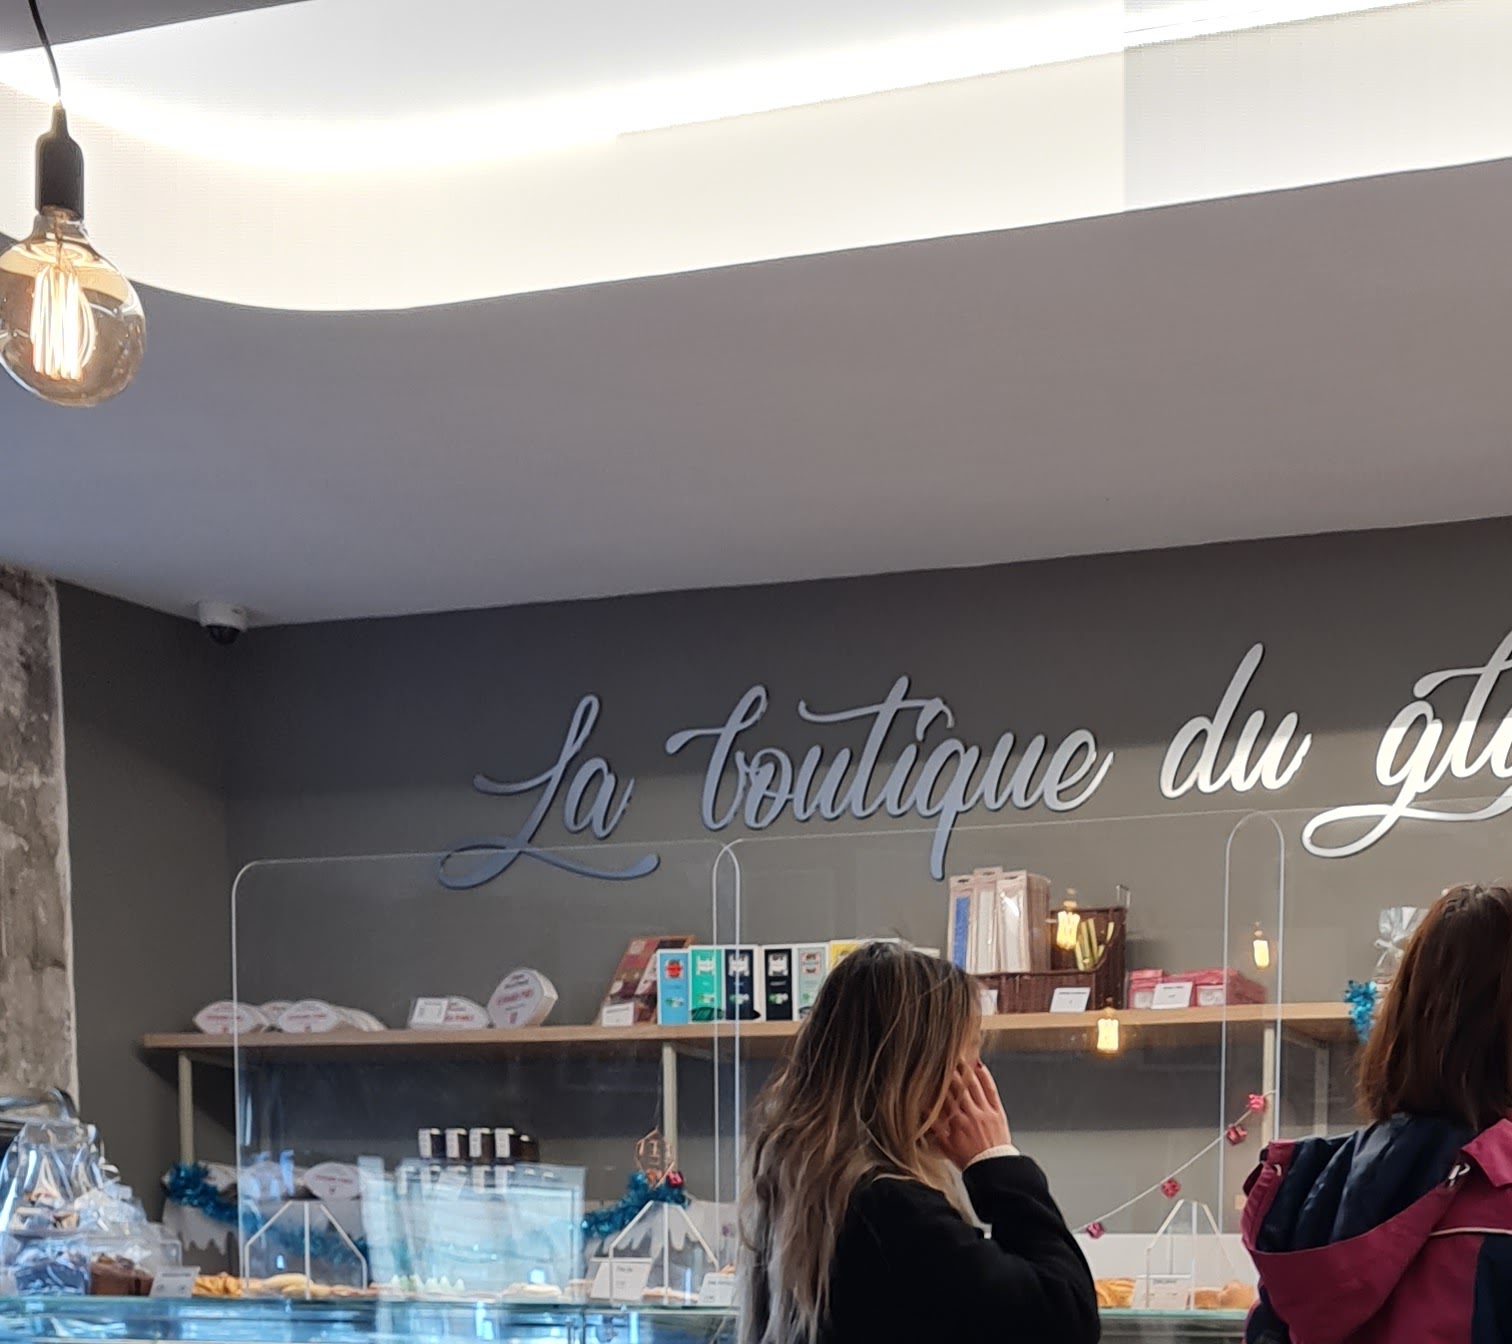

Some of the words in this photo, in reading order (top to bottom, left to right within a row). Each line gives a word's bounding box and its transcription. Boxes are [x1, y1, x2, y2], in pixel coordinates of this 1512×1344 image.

[438, 694, 660, 889] La
[666, 675, 1114, 881] boutique
[1160, 642, 1312, 799] du
